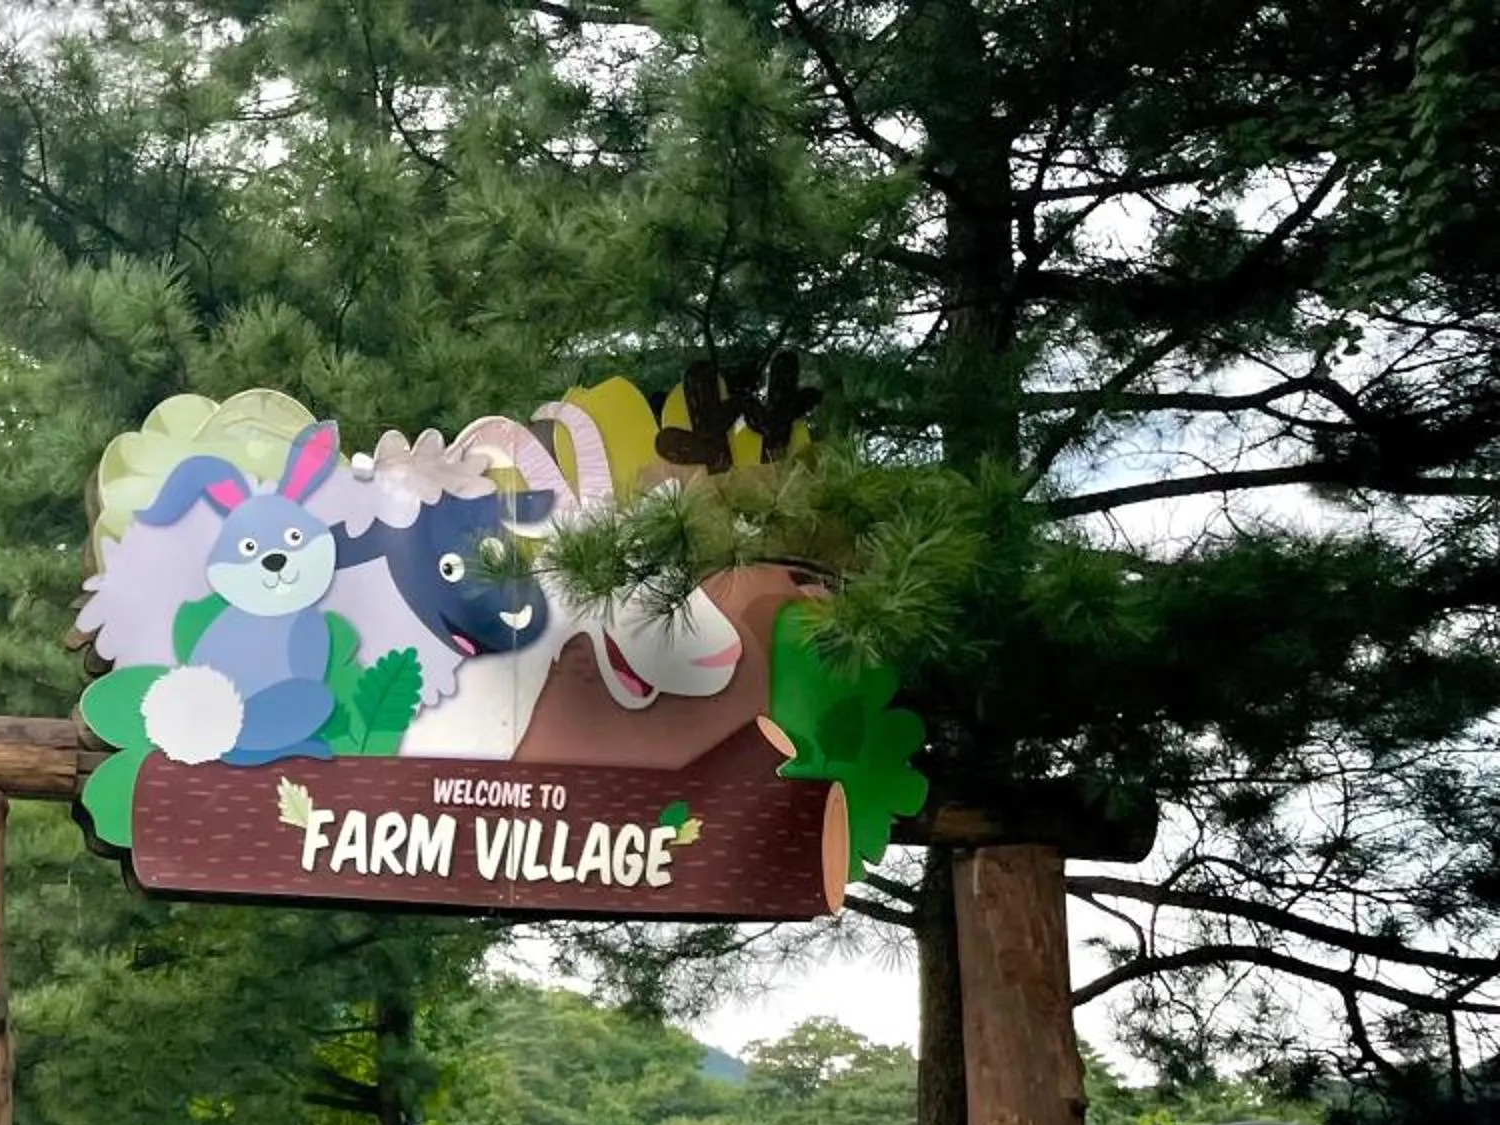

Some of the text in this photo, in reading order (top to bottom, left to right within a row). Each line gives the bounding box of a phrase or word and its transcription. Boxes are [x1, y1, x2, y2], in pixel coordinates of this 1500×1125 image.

[433, 777, 567, 811] WELCOME TO
[301, 809, 678, 888] FARM VILLAGE
